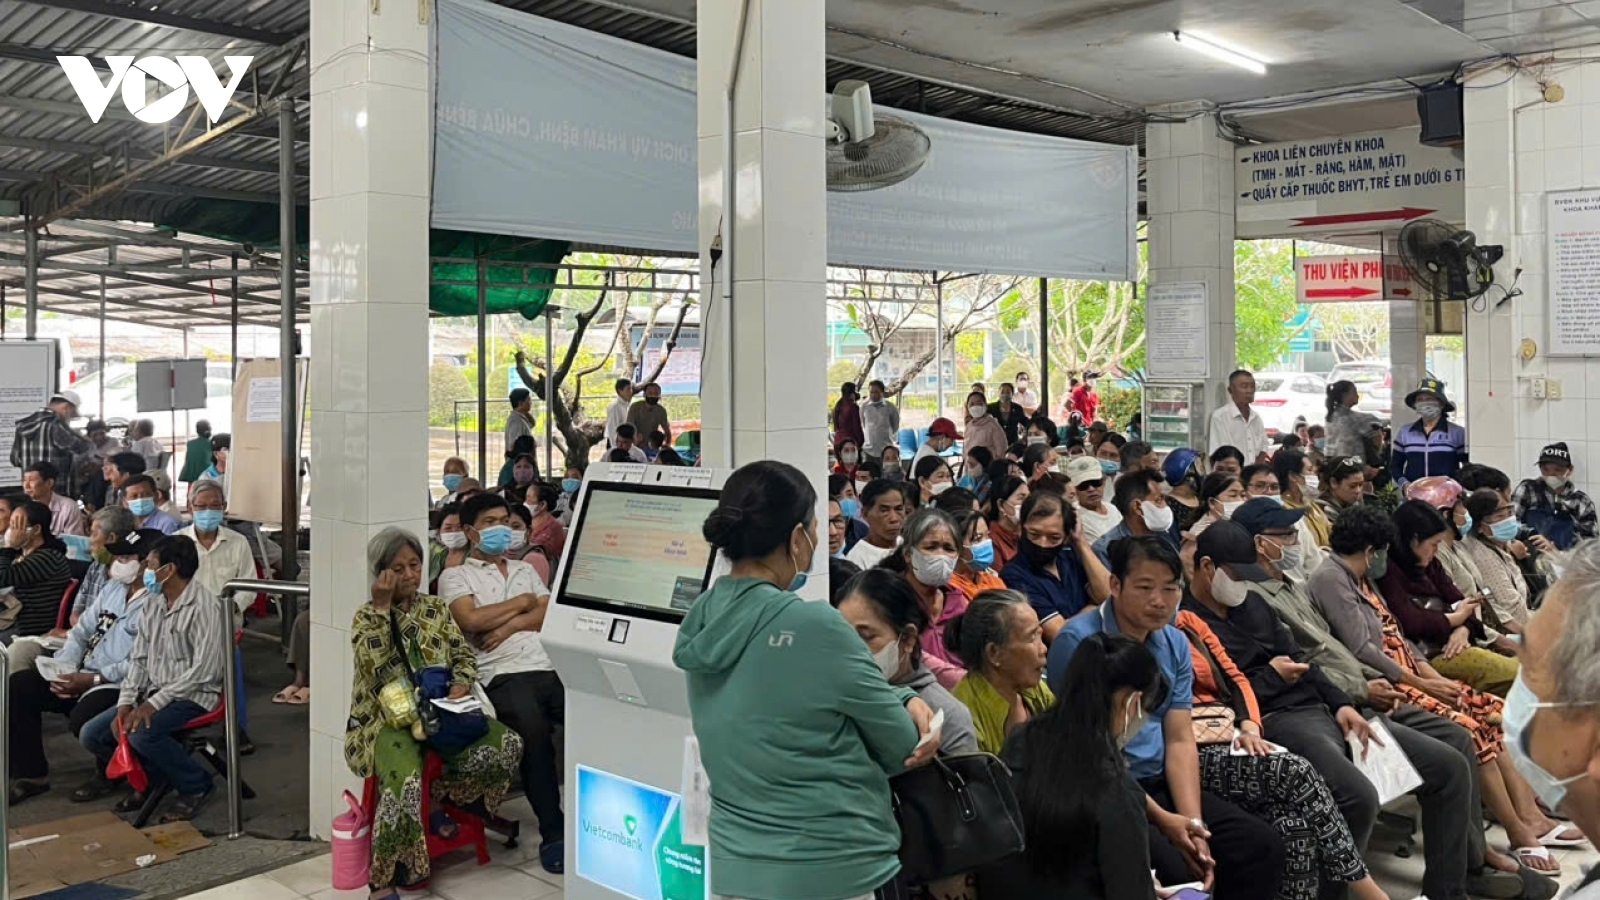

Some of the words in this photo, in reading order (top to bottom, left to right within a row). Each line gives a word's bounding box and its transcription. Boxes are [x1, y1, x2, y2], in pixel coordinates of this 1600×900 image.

[1253, 149, 1280, 163] KHOA
[1283, 144, 1306, 160] LIÊN
[1309, 138, 1351, 158] CHUYÊN
[1354, 137, 1385, 152] KHOA
[1252, 167, 1276, 183] (TMH
[1349, 156, 1375, 172] HÀM,
[1280, 180, 1299, 198] CẤP
[1302, 177, 1335, 196] THUỐC
[1370, 171, 1390, 189] TRẺ
[1394, 173, 1411, 187] EM
[1414, 167, 1441, 186] DƯỚI
[1445, 170, 1452, 182] 6
[1304, 263, 1326, 280] THU
[1331, 258, 1358, 282] VIỆN
[582, 819, 643, 852] Vietcombank
